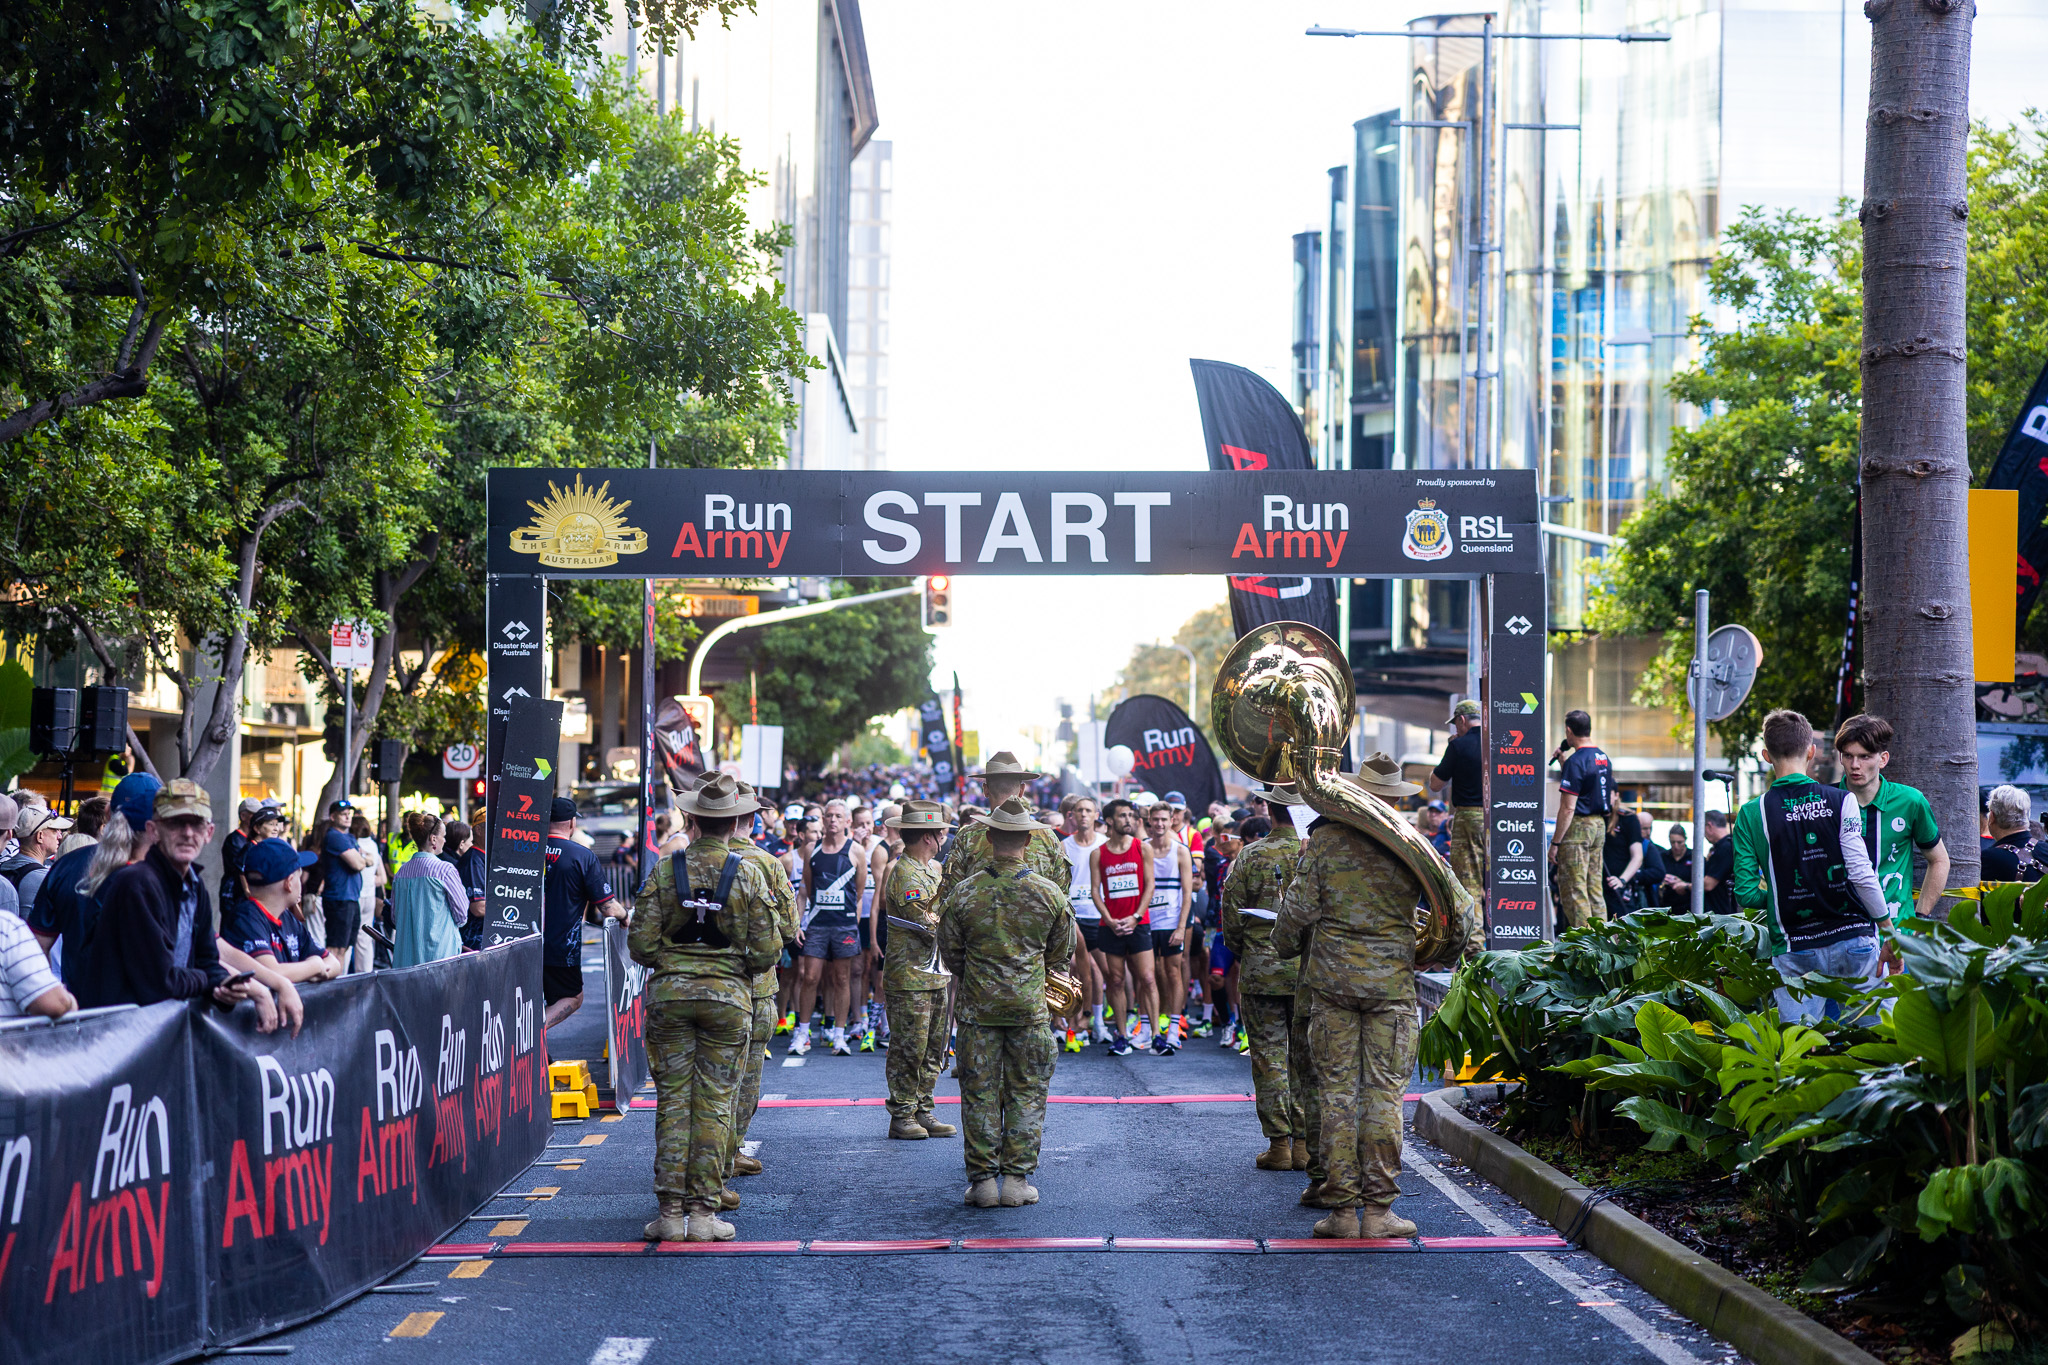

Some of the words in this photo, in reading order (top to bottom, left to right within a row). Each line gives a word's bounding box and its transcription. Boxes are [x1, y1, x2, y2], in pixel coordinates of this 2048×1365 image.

[1416, 478, 1446, 487] Proudly
[1446, 478, 1485, 487] sponsored
[1486, 478, 1496, 487] by
[705, 494, 792, 531] Run
[1263, 495, 1349, 531] Run
[862, 490, 1171, 565] START
[1460, 516, 1513, 538] RSL
[604, 541, 640, 551] ARMY
[671, 522, 791, 568] Army
[1231, 523, 1348, 568] Army
[1461, 544, 1513, 553] Queensland
[544, 554, 613, 565] AUSTRALIAN
[1143, 727, 1195, 753] Run
[1509, 730, 1524, 747] 7
[451, 748, 472, 762] 20
[1131, 743, 1195, 773] Army
[1500, 747, 1533, 755] NEWS
[505, 763, 532, 773] Defence
[510, 771, 531, 779] Health
[1497, 764, 1534, 775] nova
[1510, 776, 1535, 786] 106.9
[518, 794, 533, 812] 7
[1784, 792, 1821, 809] sports
[1793, 799, 1827, 813] event
[506, 811, 540, 821] NEWS
[1786, 808, 1833, 821] services
[1497, 820, 1535, 832] Chief.
[501, 827, 540, 842] nova
[513, 840, 539, 853] 106.9
[507, 867, 539, 876] BROOKS
[1511, 869, 1537, 880] GSA
[1112, 880, 1135, 889] 2926
[494, 885, 533, 900] Chief.
[820, 895, 840, 903] 3274
[1497, 898, 1536, 910] Ferra
[1494, 925, 1535, 936] QBANK
[515, 986, 534, 1056] Run
[481, 1000, 504, 1075] Run
[437, 1014, 465, 1097] Run
[375, 1029, 423, 1121] Run
[509, 1044, 533, 1123] Army
[255, 1055, 335, 1155] Run
[428, 1083, 466, 1174] Army
[92, 1084, 169, 1199] Run
[357, 1107, 418, 1204] Army
[222, 1139, 333, 1247] Army
[45, 1182, 169, 1304] Army
